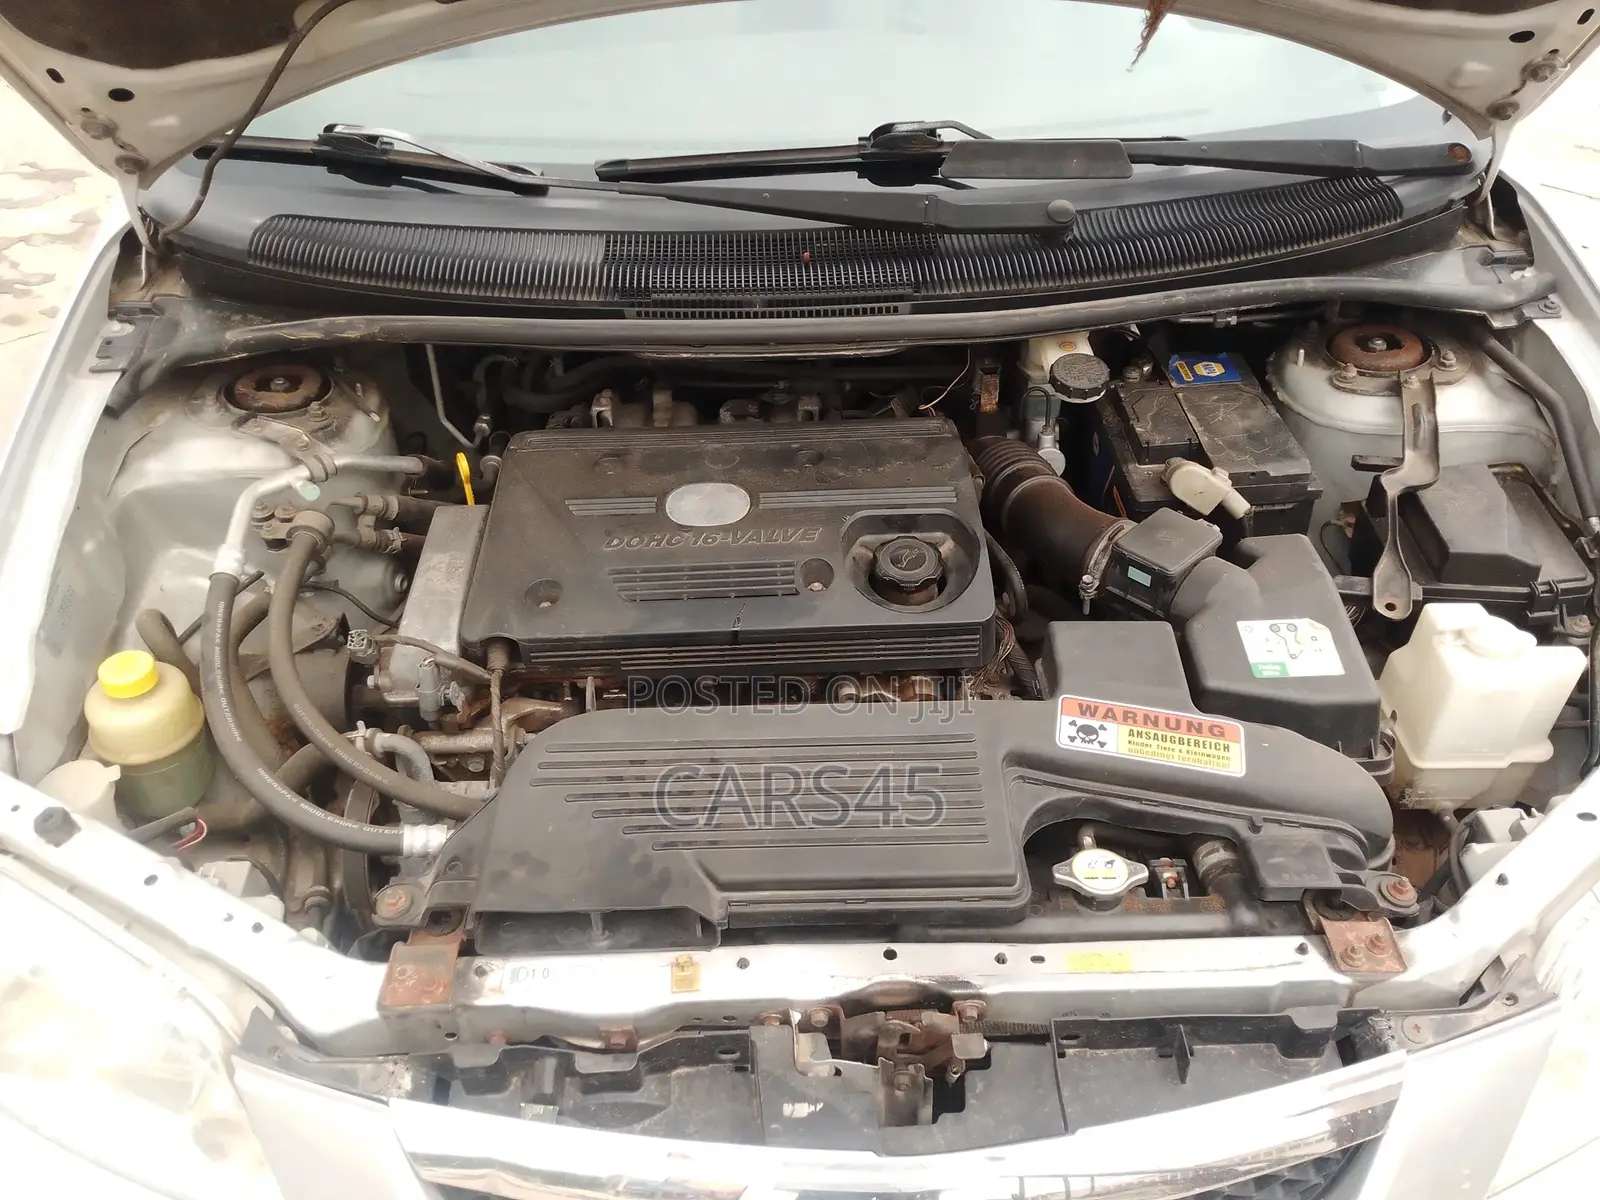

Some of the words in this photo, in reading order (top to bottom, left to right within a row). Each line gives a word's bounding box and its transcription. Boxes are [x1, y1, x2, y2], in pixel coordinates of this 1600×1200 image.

[603, 531, 690, 550] DOHC
[691, 527, 823, 547] 16-VALVE
[1077, 702, 1226, 738] WARNUNG
[1128, 728, 1230, 753] ANSAUGBEREICH
[1128, 740, 1152, 749] Kinder
